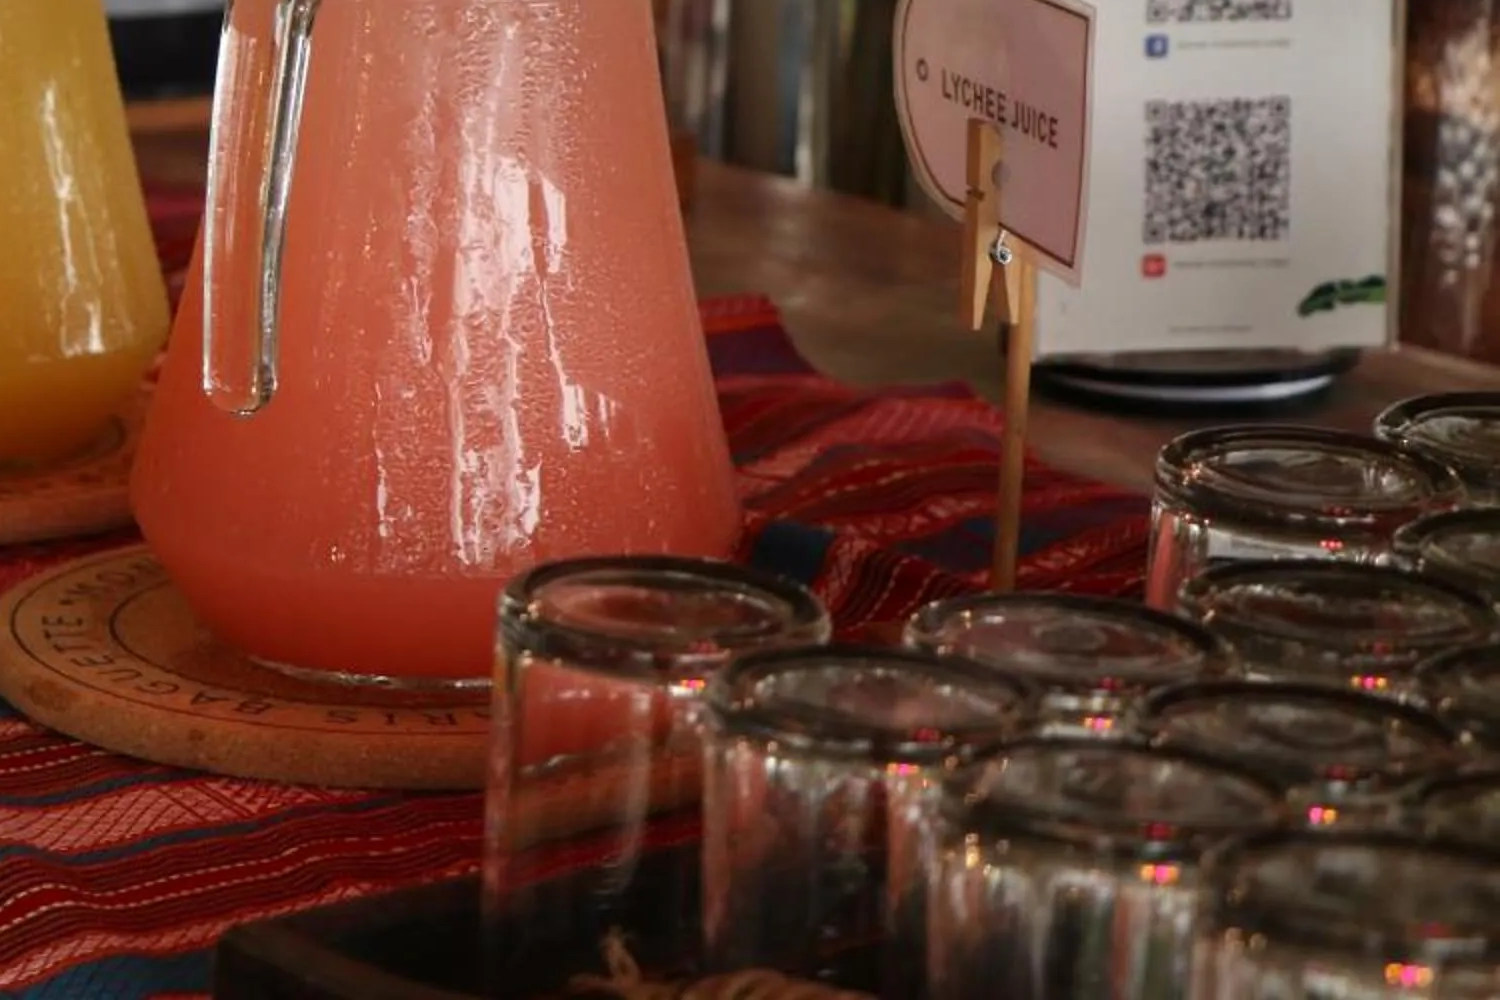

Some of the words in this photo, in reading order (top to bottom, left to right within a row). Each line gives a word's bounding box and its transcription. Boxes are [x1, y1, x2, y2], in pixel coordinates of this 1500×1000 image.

[941, 67, 1007, 126] LYCHEE
[1011, 100, 1059, 150] JUICE
[41, 615, 274, 715] BAGUETTE
